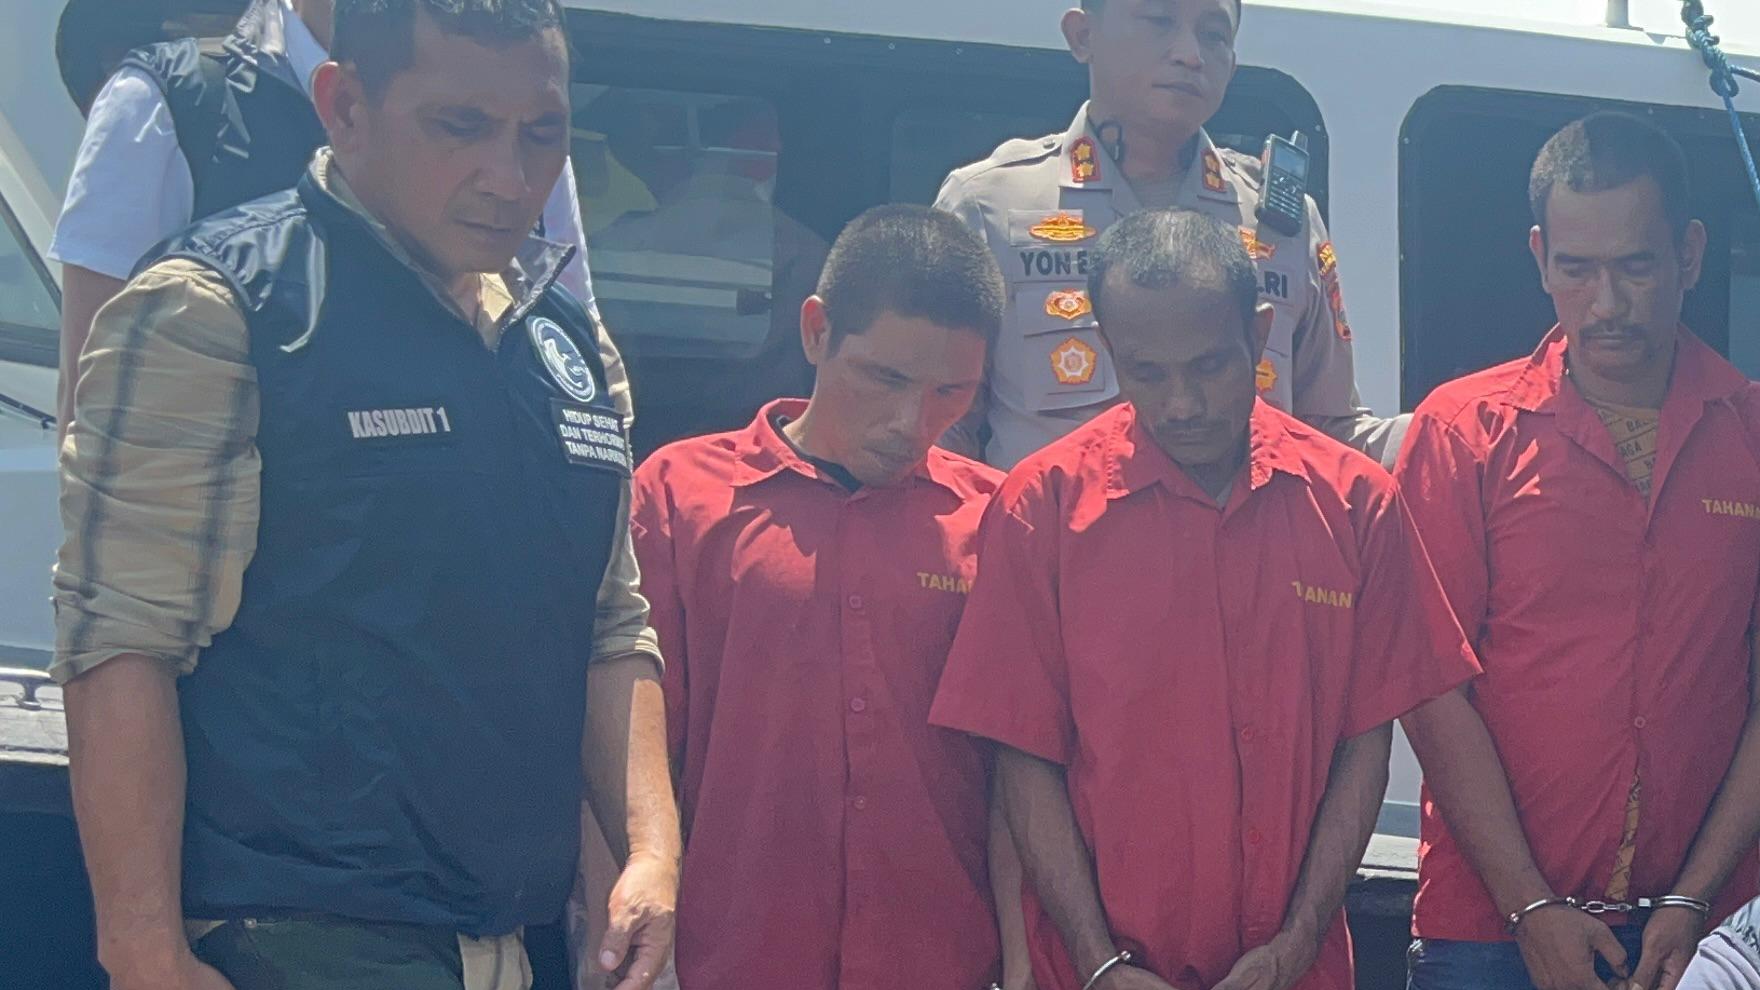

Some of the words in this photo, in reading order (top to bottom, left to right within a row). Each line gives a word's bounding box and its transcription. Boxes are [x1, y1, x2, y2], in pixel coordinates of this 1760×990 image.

[1020, 251, 1072, 276] YON
[347, 408, 436, 438] KASUBDIT
[436, 406, 451, 432] 1
[559, 424, 582, 440] DAN
